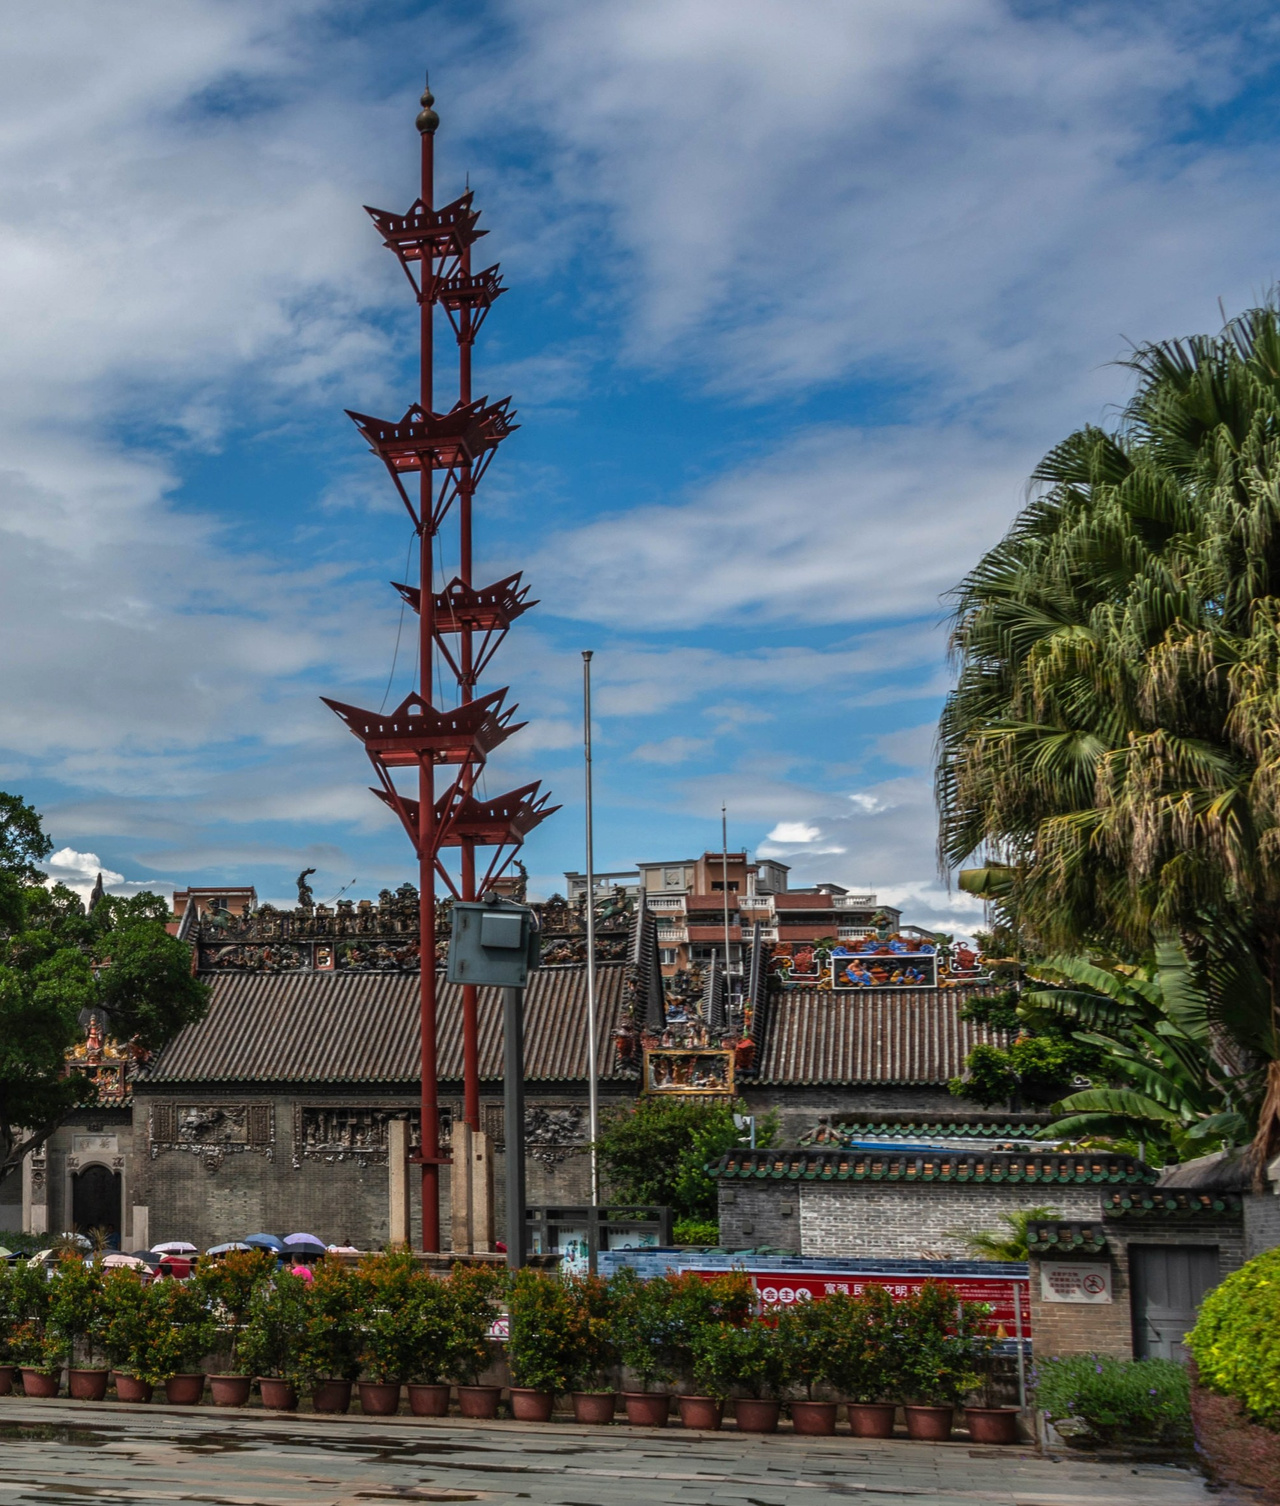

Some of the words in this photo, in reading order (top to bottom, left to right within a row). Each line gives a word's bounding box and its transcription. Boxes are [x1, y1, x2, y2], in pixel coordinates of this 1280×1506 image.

[755, 1288, 811, 1302] 会主义
[824, 1282, 849, 1295] 富强
[882, 1285, 908, 1298] 文明
